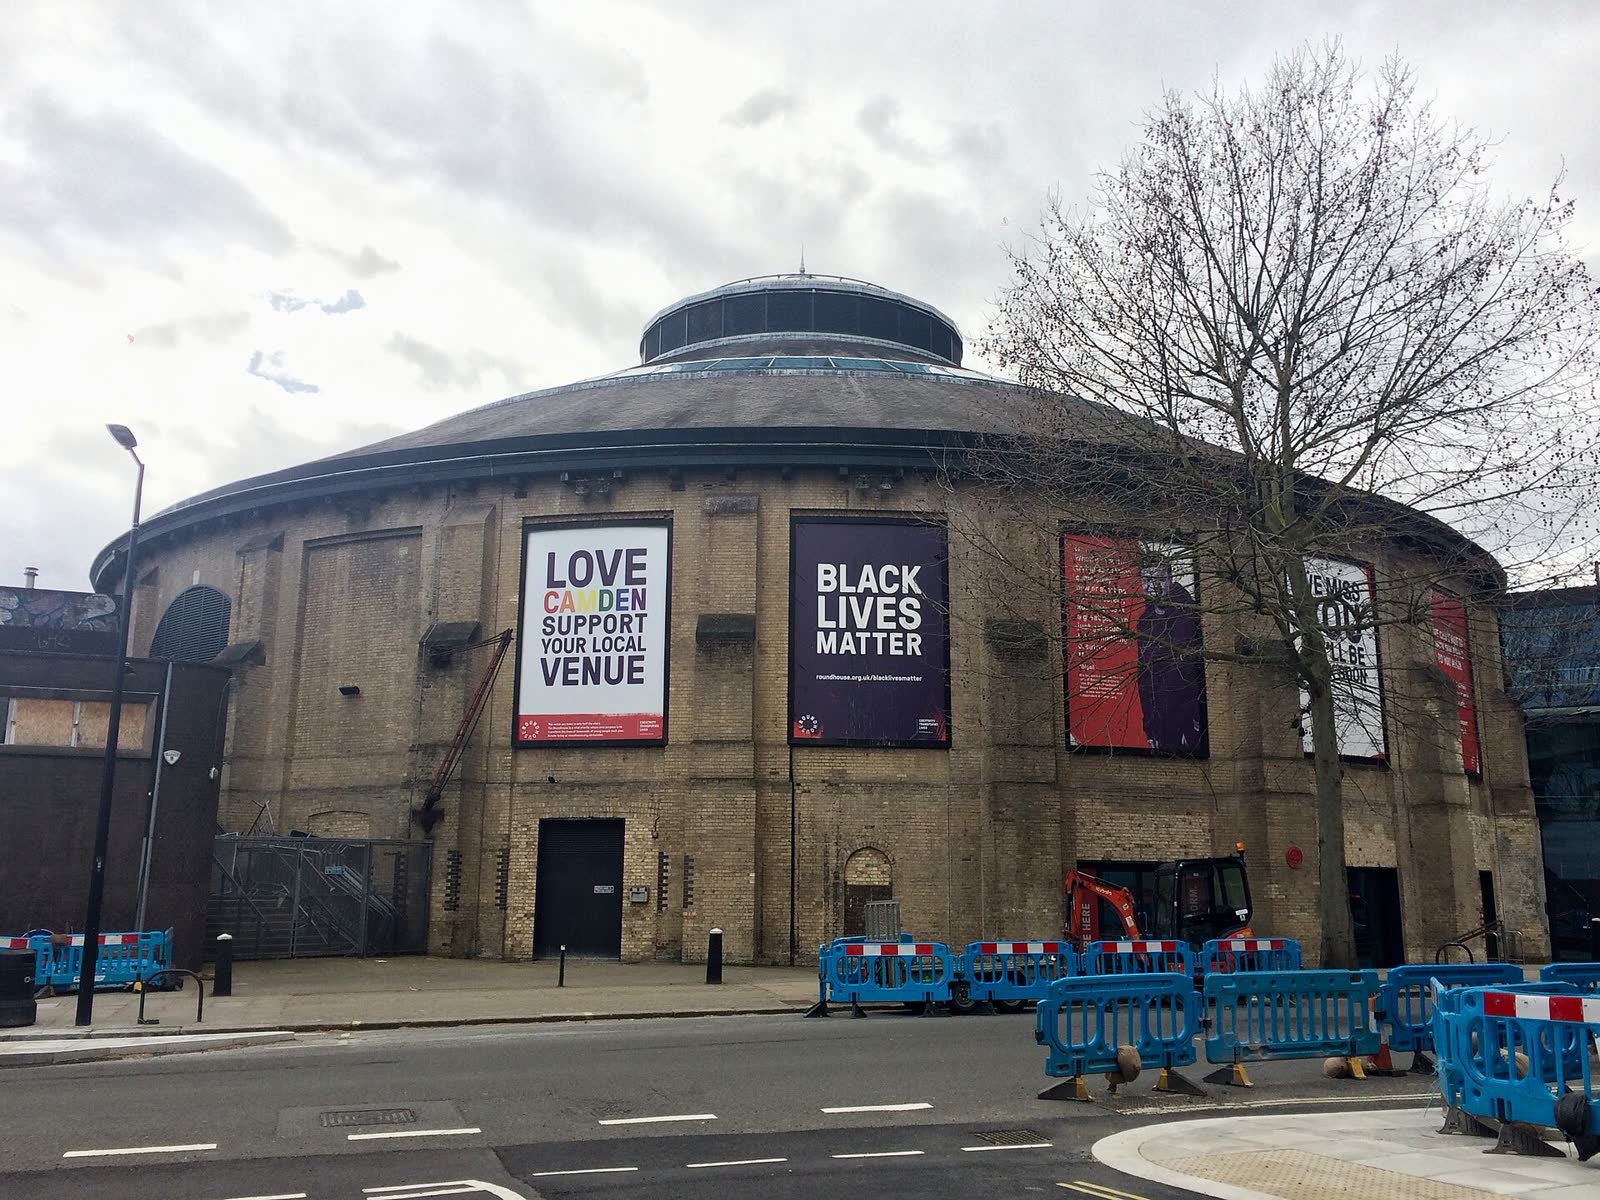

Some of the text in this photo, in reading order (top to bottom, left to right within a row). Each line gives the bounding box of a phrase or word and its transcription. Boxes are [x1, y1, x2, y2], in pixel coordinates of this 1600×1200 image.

[546, 548, 648, 589] LOVE
[817, 563, 922, 595] BLACK
[544, 588, 647, 614] CAMDEN
[817, 595, 922, 631] LIVES
[542, 613, 648, 636] SUPPORT
[541, 635, 647, 654] YOUR LOCAL
[816, 631, 922, 656] MATTER
[540, 655, 645, 687] VENUE
[816, 674, 923, 682] roundhouse.org.uk/blacklivesmatter
[1081, 903, 1091, 931] HERE
